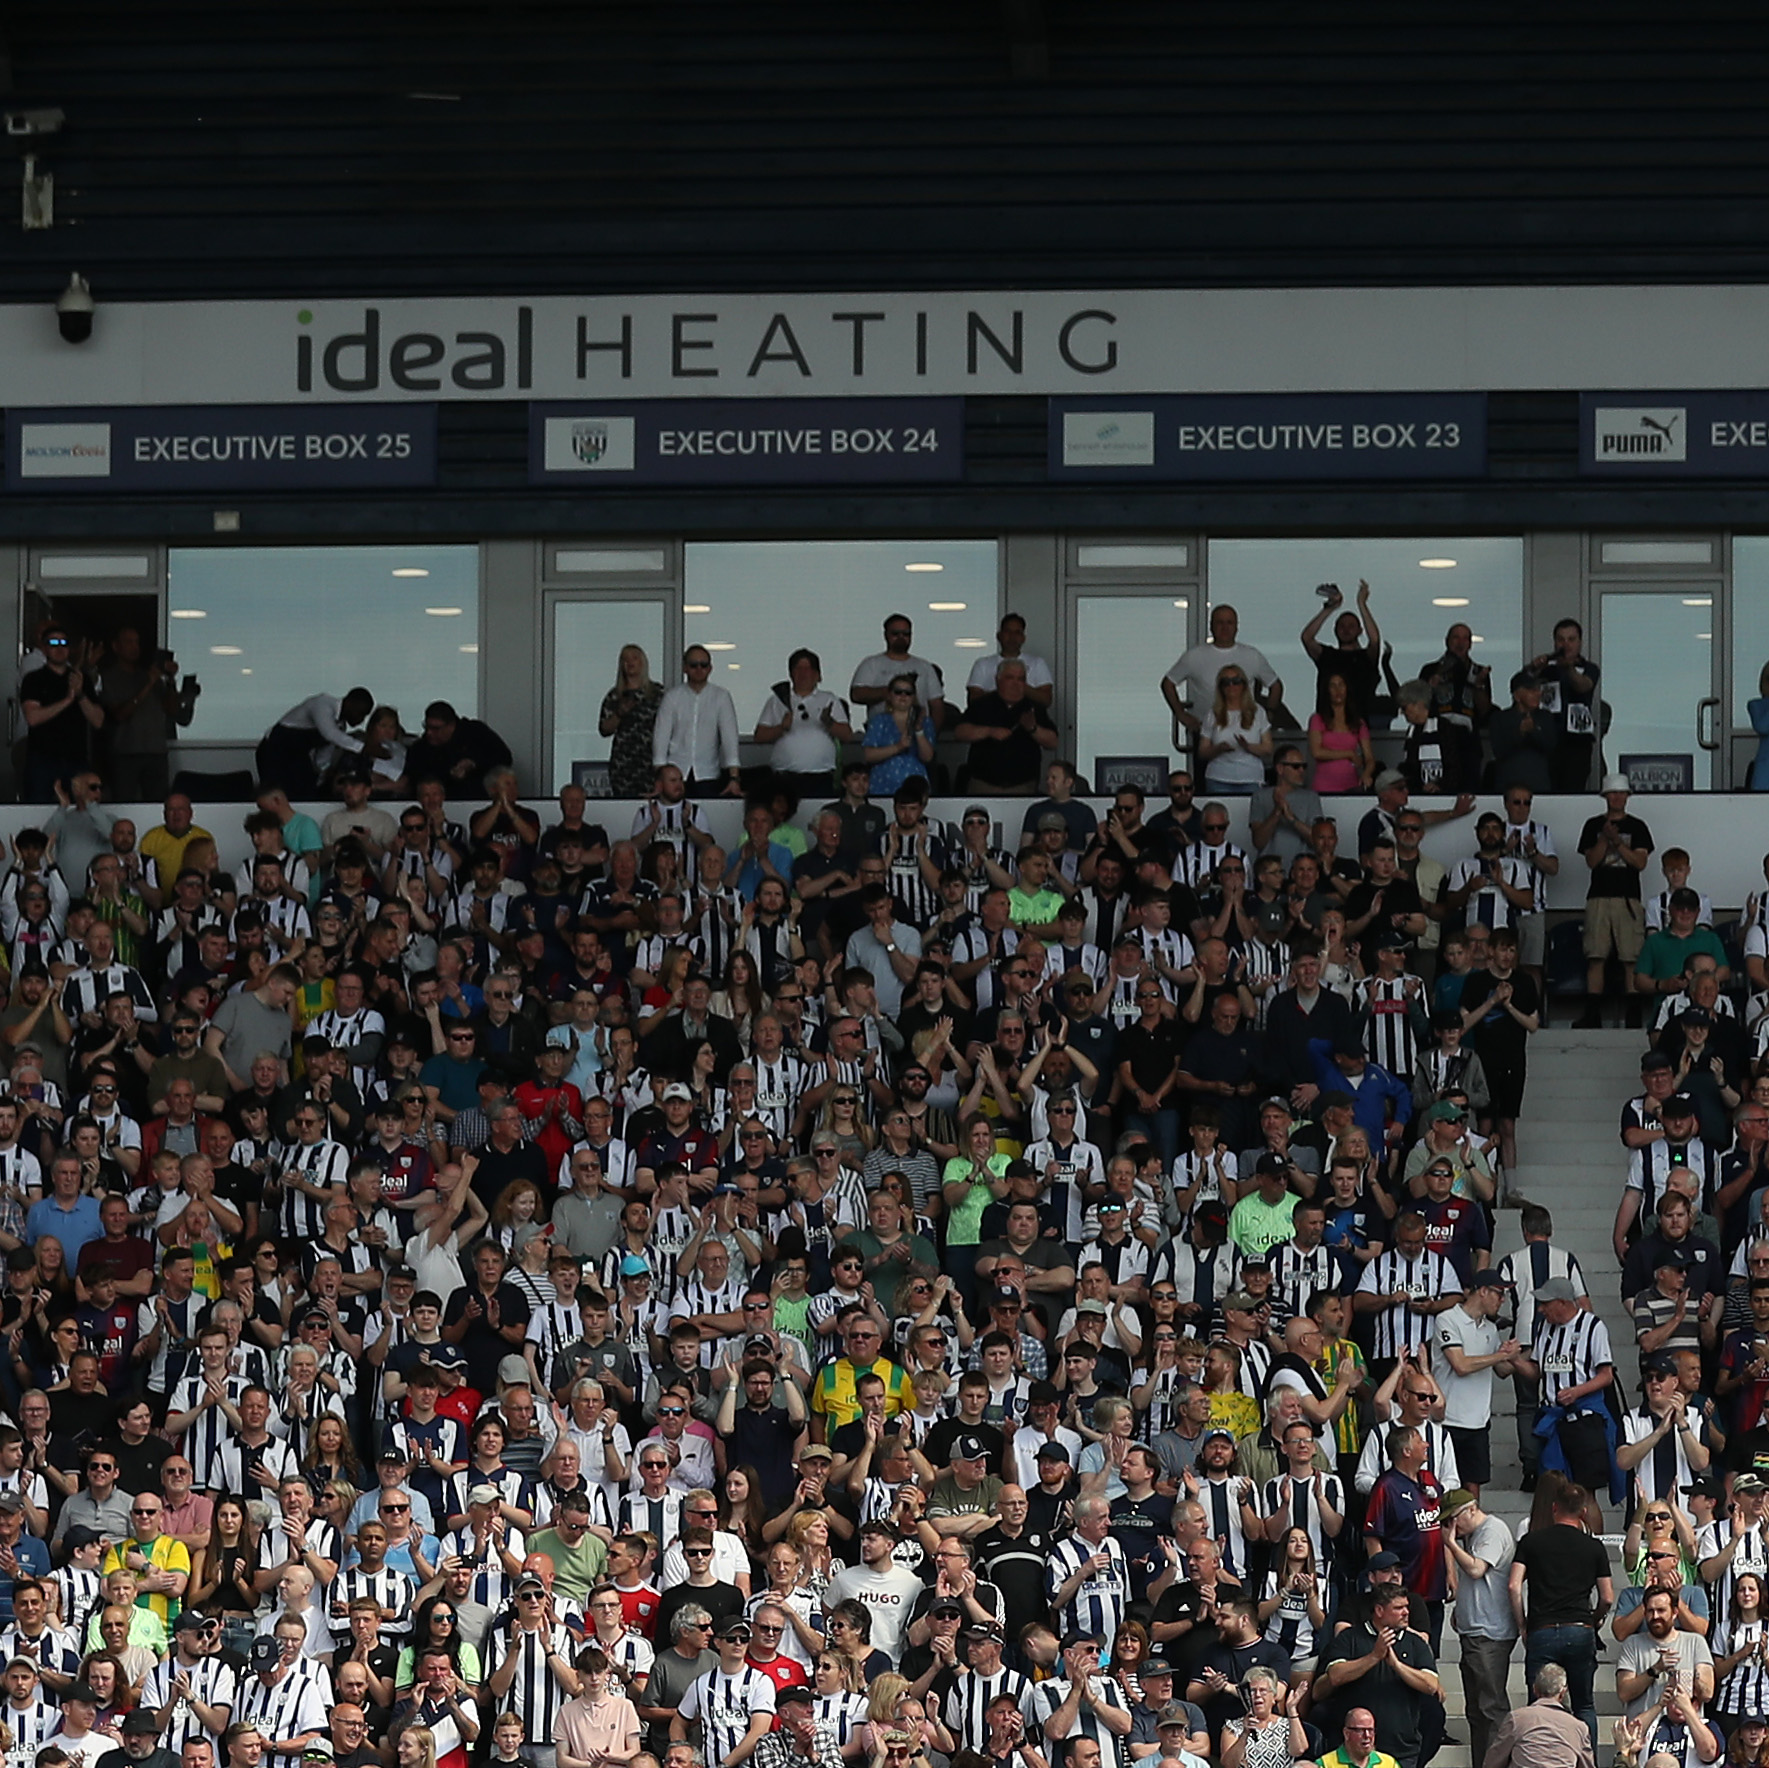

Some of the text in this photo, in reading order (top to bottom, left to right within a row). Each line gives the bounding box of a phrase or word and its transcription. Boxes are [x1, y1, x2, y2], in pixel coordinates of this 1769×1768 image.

[298, 306, 1117, 392] ideal HEATING
[660, 429, 938, 454] EXECUTIVE BOX 24
[1180, 424, 1459, 449] EXECUTIVE BOX 23
[135, 435, 410, 460] EXECUTIVE BOX 25
[1603, 434, 1662, 454] PUMA
[1108, 773, 1157, 784] ALBION
[1632, 771, 1679, 782] ALBION
[892, 857, 918, 866] ideal
[1257, 1232, 1292, 1245] ideal
[1441, 1332, 1451, 1341] 6
[1414, 1507, 1441, 1525] ideal
[1733, 1556, 1764, 1569] ideal
[859, 1592, 900, 1606] HUGO
[712, 1707, 744, 1720] ideal
[1653, 1740, 1685, 1754] ideal
